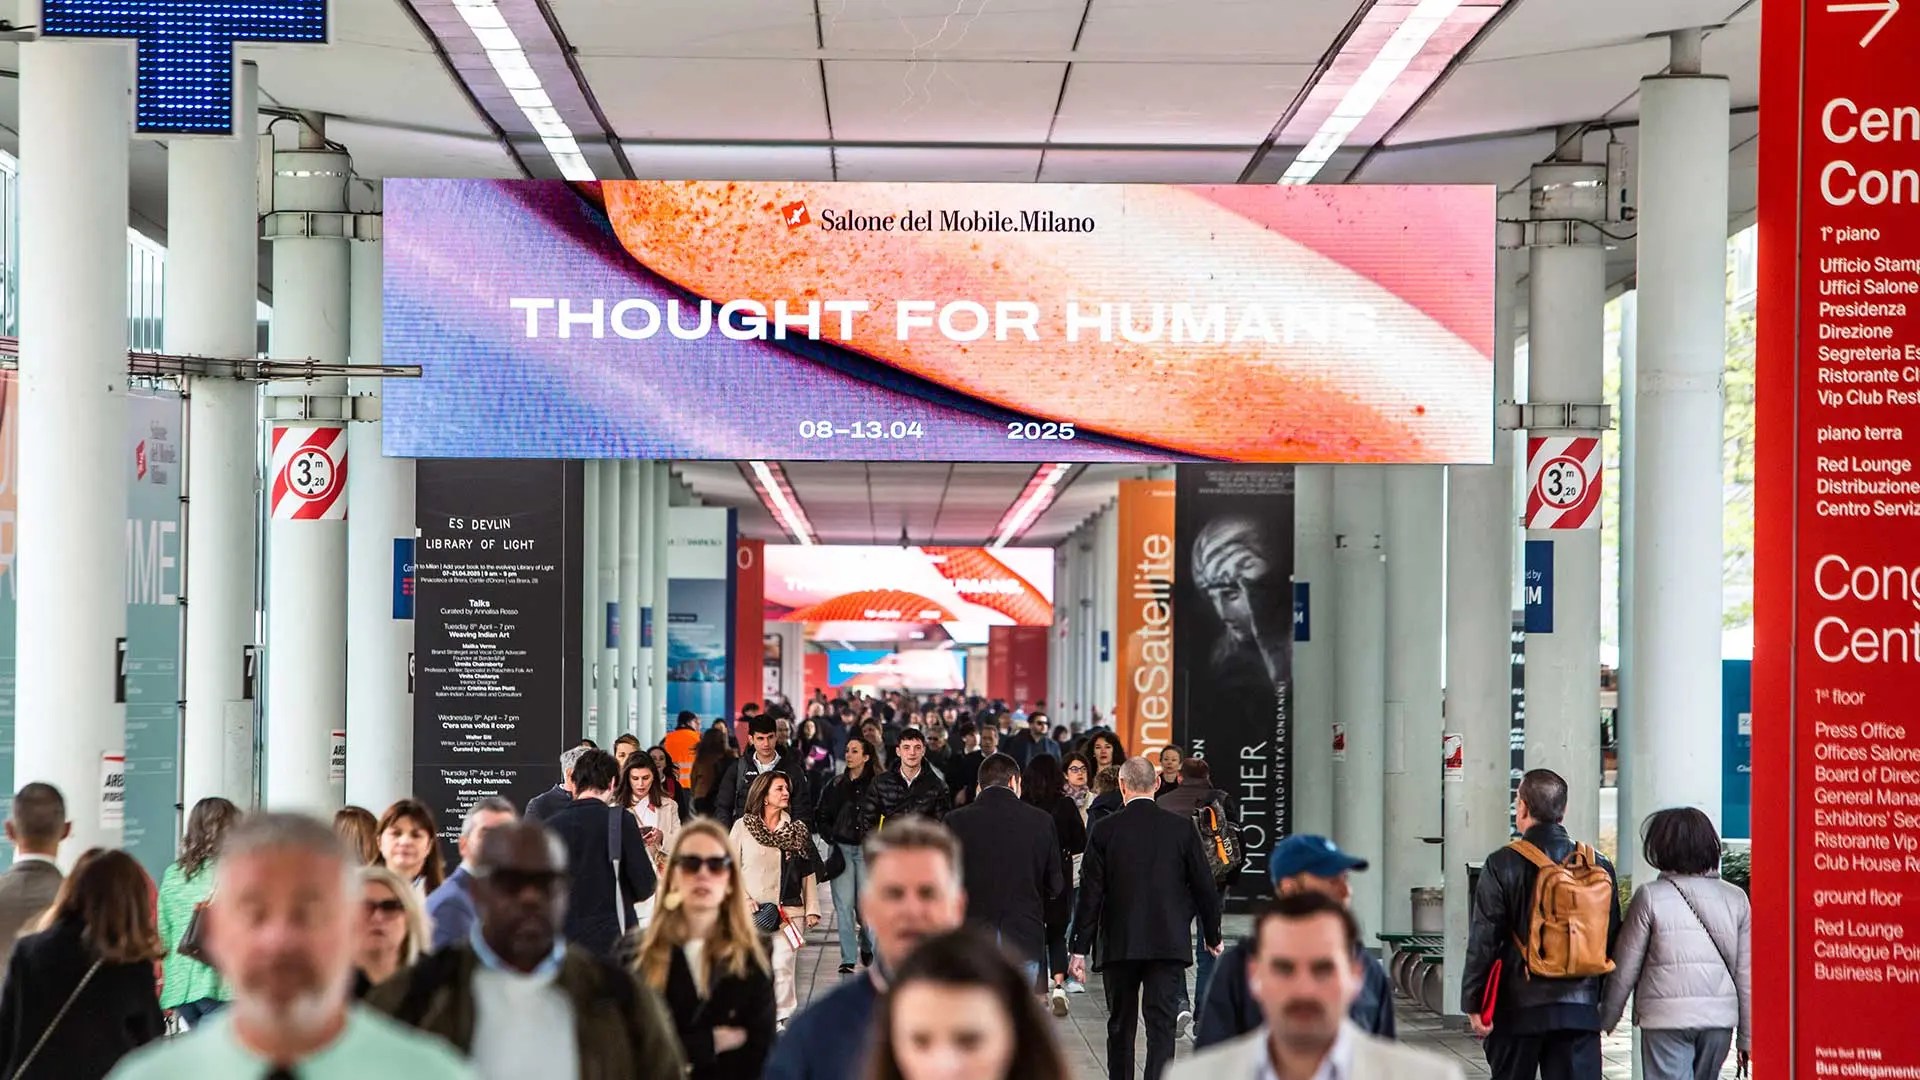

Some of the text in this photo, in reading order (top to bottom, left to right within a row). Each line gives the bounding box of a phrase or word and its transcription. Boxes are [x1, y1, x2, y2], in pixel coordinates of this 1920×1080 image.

[1821, 97, 1920, 143] Cen
[1820, 160, 1920, 206] Con
[821, 208, 1095, 233] Salone del Mobile.Milano
[1836, 226, 1880, 244] piano
[1820, 258, 1870, 273] Ufficio
[1820, 279, 1918, 295] Uffici Salone
[1820, 302, 1906, 316] Presidenza
[509, 298, 869, 340] THOUGHT
[896, 299, 1041, 342] FOR
[1820, 324, 1893, 339] Direzione
[1818, 346, 1900, 364] Segreteria
[1819, 368, 1899, 382] Ristorante
[1818, 390, 1843, 408] Vip
[1846, 390, 1883, 404] Club
[1007, 422, 1075, 440] 2025
[1818, 426, 1902, 443] piano terra
[297, 459, 312, 486] 3
[1818, 457, 1911, 475] Red Lounge
[1548, 469, 1562, 496] 3
[1818, 479, 1920, 494] Distribuzione
[1817, 500, 1870, 516] Centro
[449, 518, 510, 530] ES DEVLIN
[426, 539, 534, 549] LIBRARY OF LIGHT
[444, 623, 468, 632] Tuesday
[1832, 689, 1865, 704] floor
[1816, 722, 1905, 739] Press Office
[1815, 744, 1867, 760] Offices
[1816, 766, 1920, 784] Board of Direc
[1815, 787, 1872, 804] General
[1240, 741, 1267, 874] MOTHER
[1815, 809, 1890, 827] Exhibitors'
[1815, 831, 1918, 852] Ristorante Vip
[1814, 854, 1849, 870] Club
[1853, 855, 1901, 872] House
[1814, 889, 1902, 906] ground floor
[1815, 918, 1903, 942] Red Lounge
[1814, 940, 1890, 962] Catalogue
[1815, 963, 1920, 984] Business Poin
[1816, 1060, 1839, 1075] Bus
